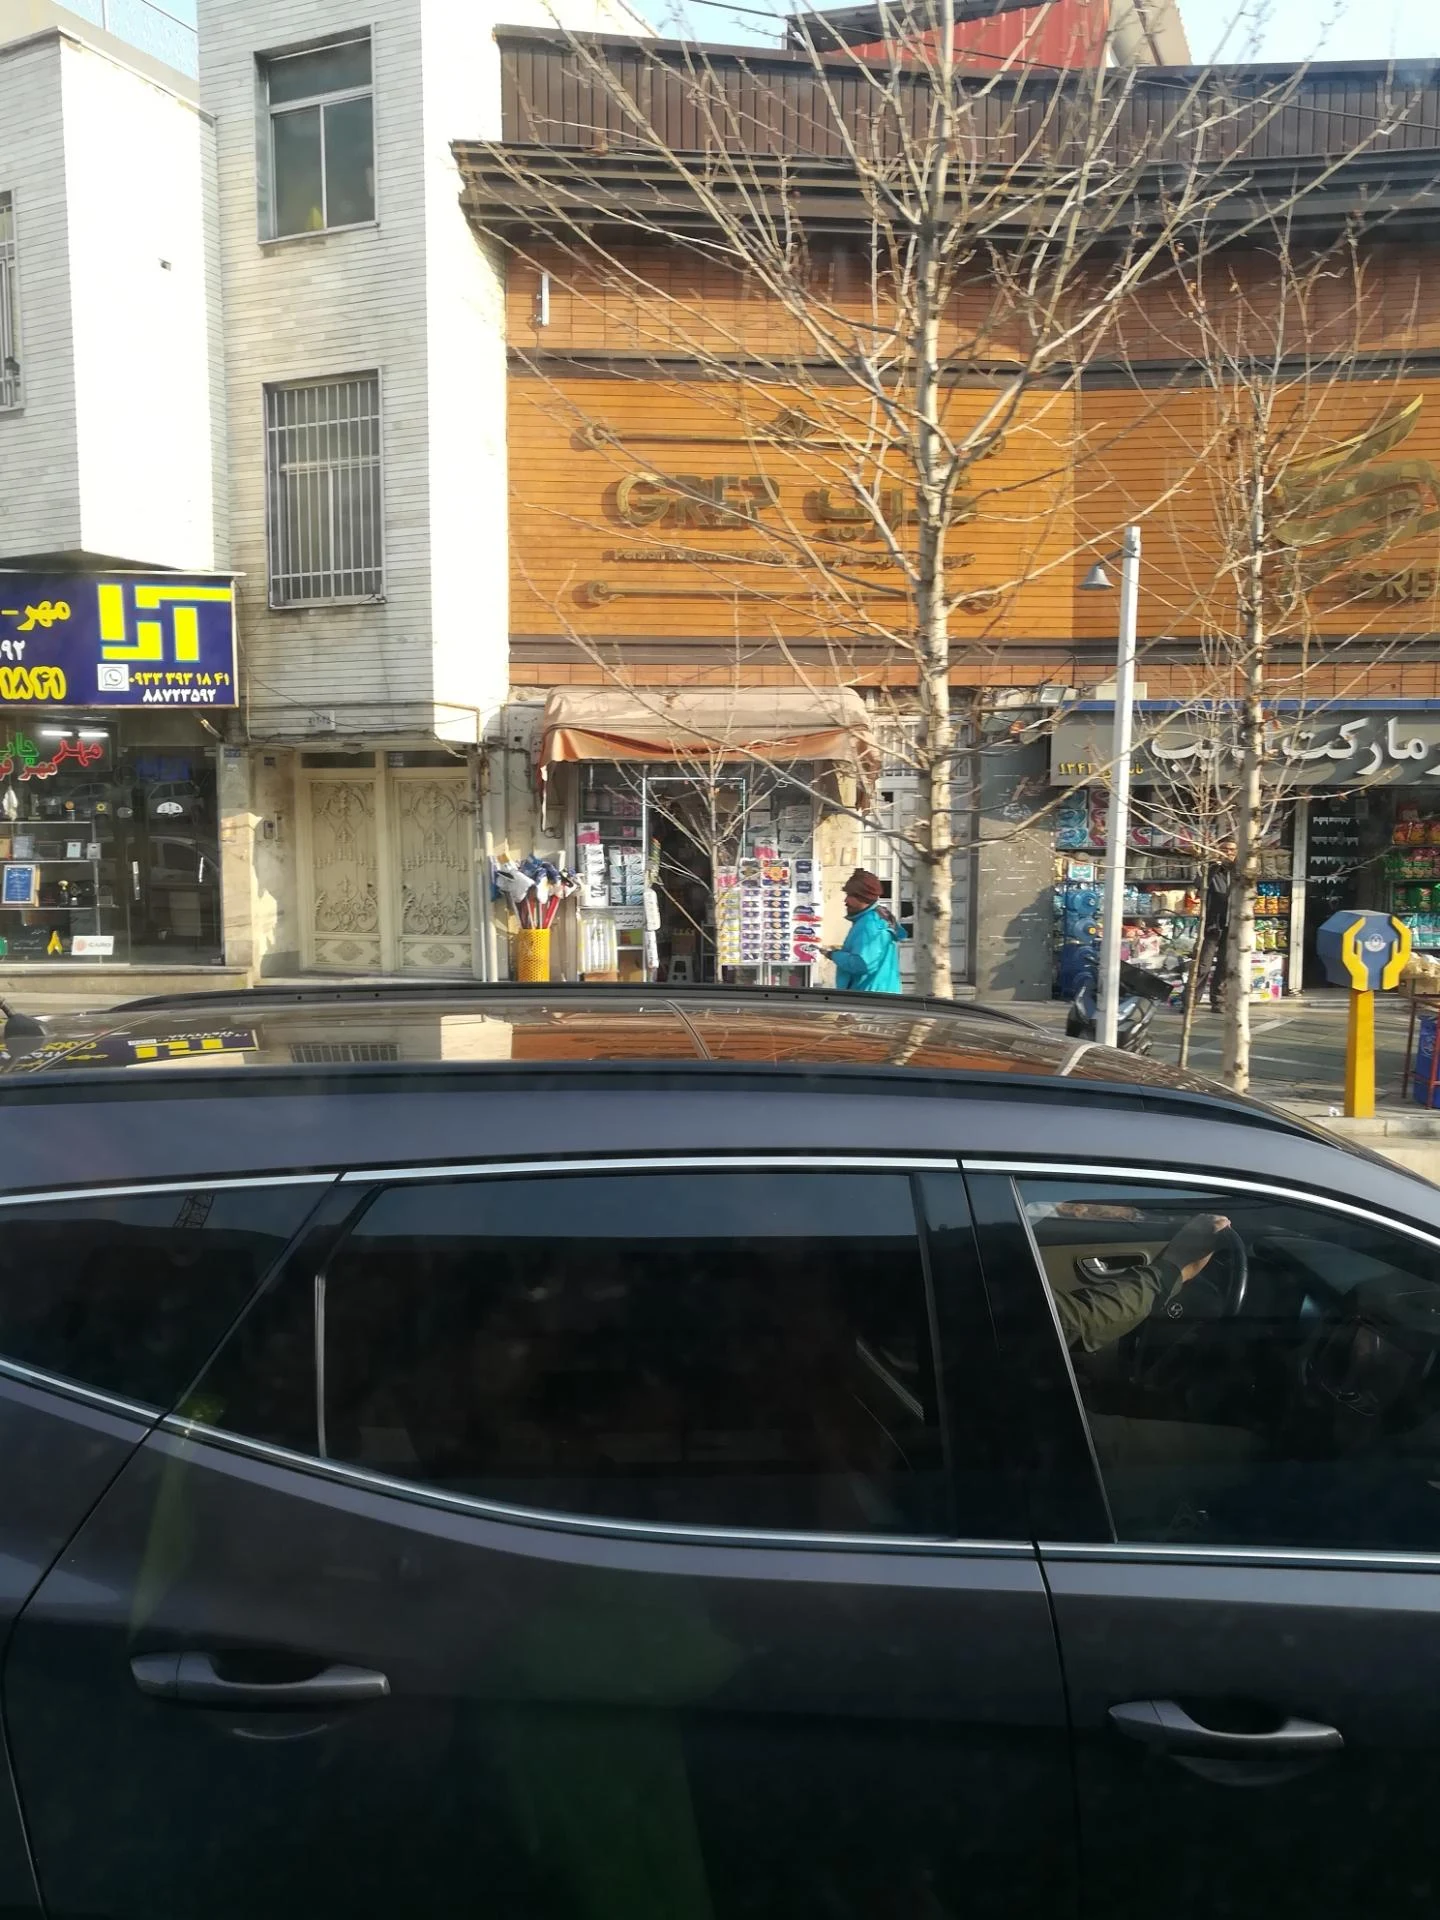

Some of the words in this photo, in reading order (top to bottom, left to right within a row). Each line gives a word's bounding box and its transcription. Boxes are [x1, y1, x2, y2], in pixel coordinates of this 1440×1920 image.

[617, 472, 780, 525] GREP
[17, 601, 71, 631] مهر
[0, 639, 26, 661] ۹۲
[1281, 716, 1429, 776] مارکت
